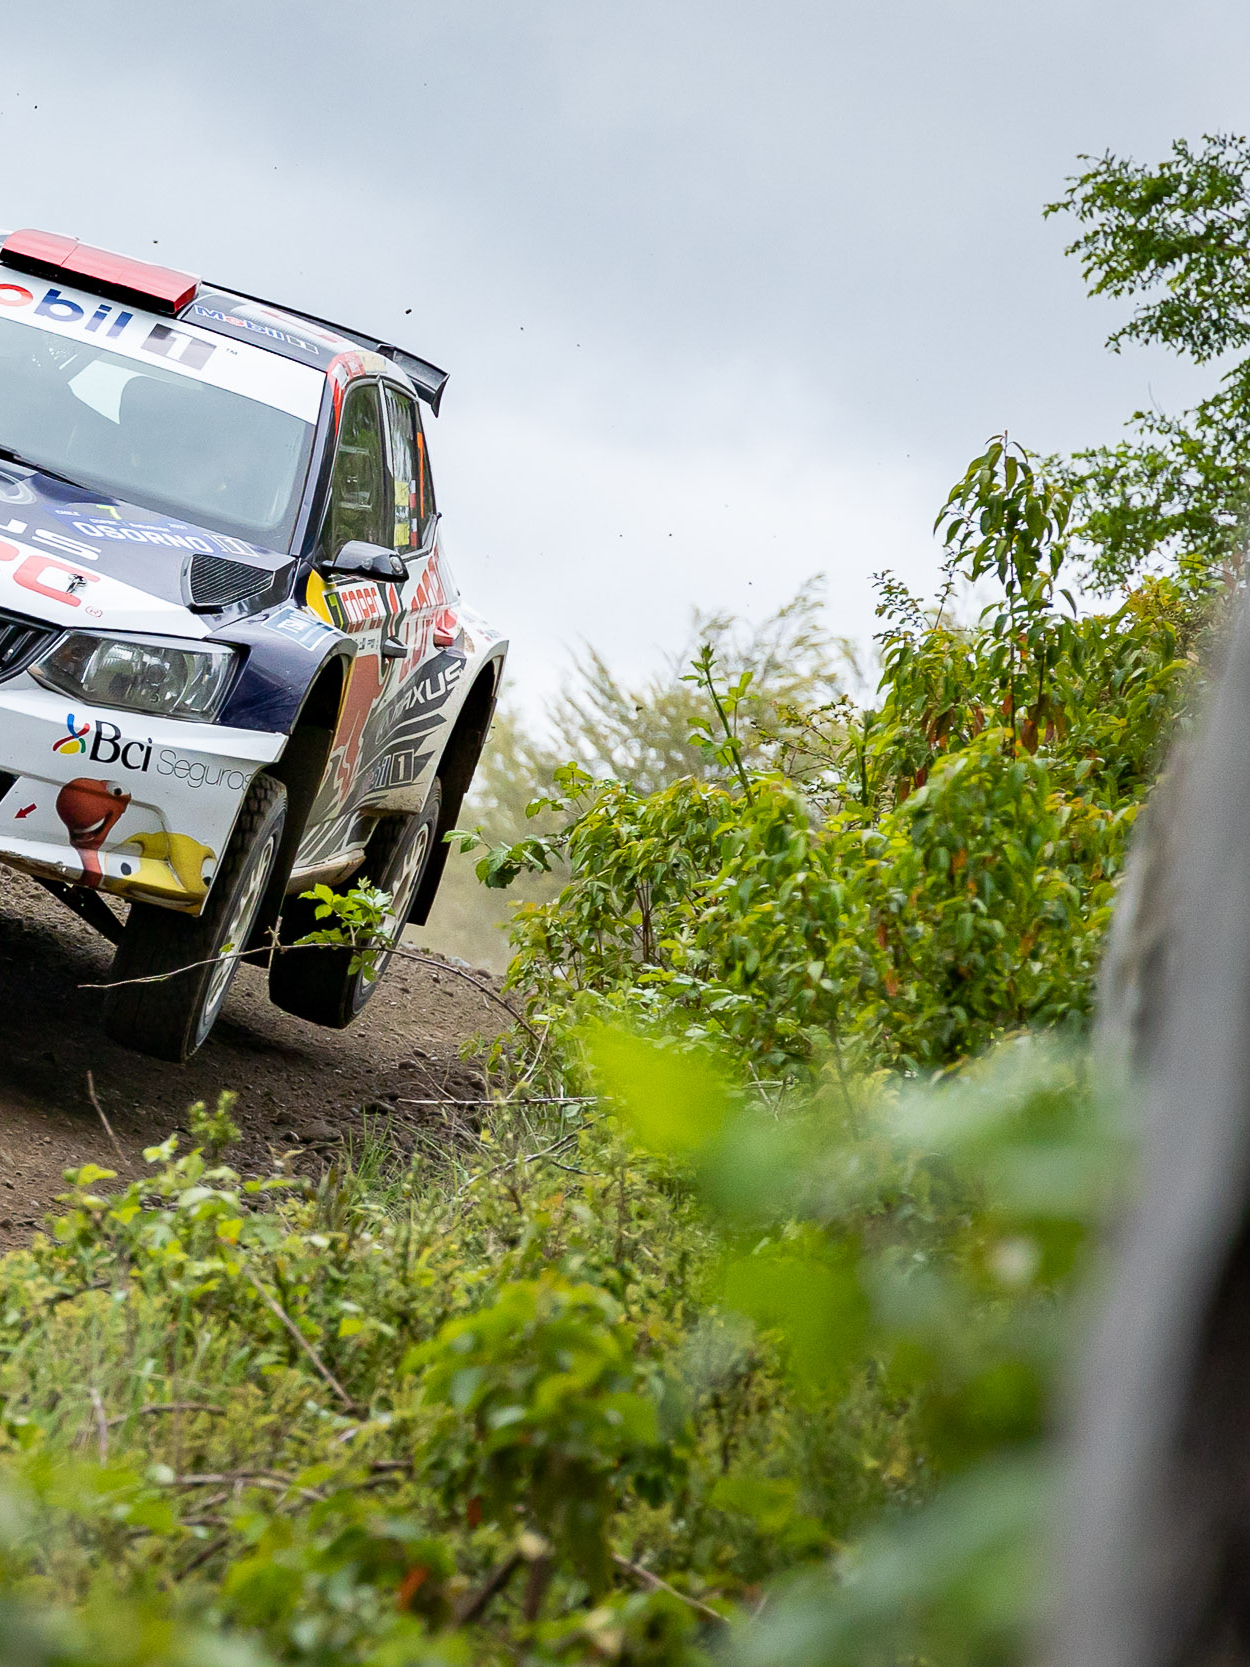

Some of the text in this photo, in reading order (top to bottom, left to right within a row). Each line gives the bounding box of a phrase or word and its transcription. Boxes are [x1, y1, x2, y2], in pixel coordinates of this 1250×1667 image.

[193, 304, 284, 342] Mobil
[72, 521, 214, 553] OSORNO
[89, 720, 153, 772] Bci
